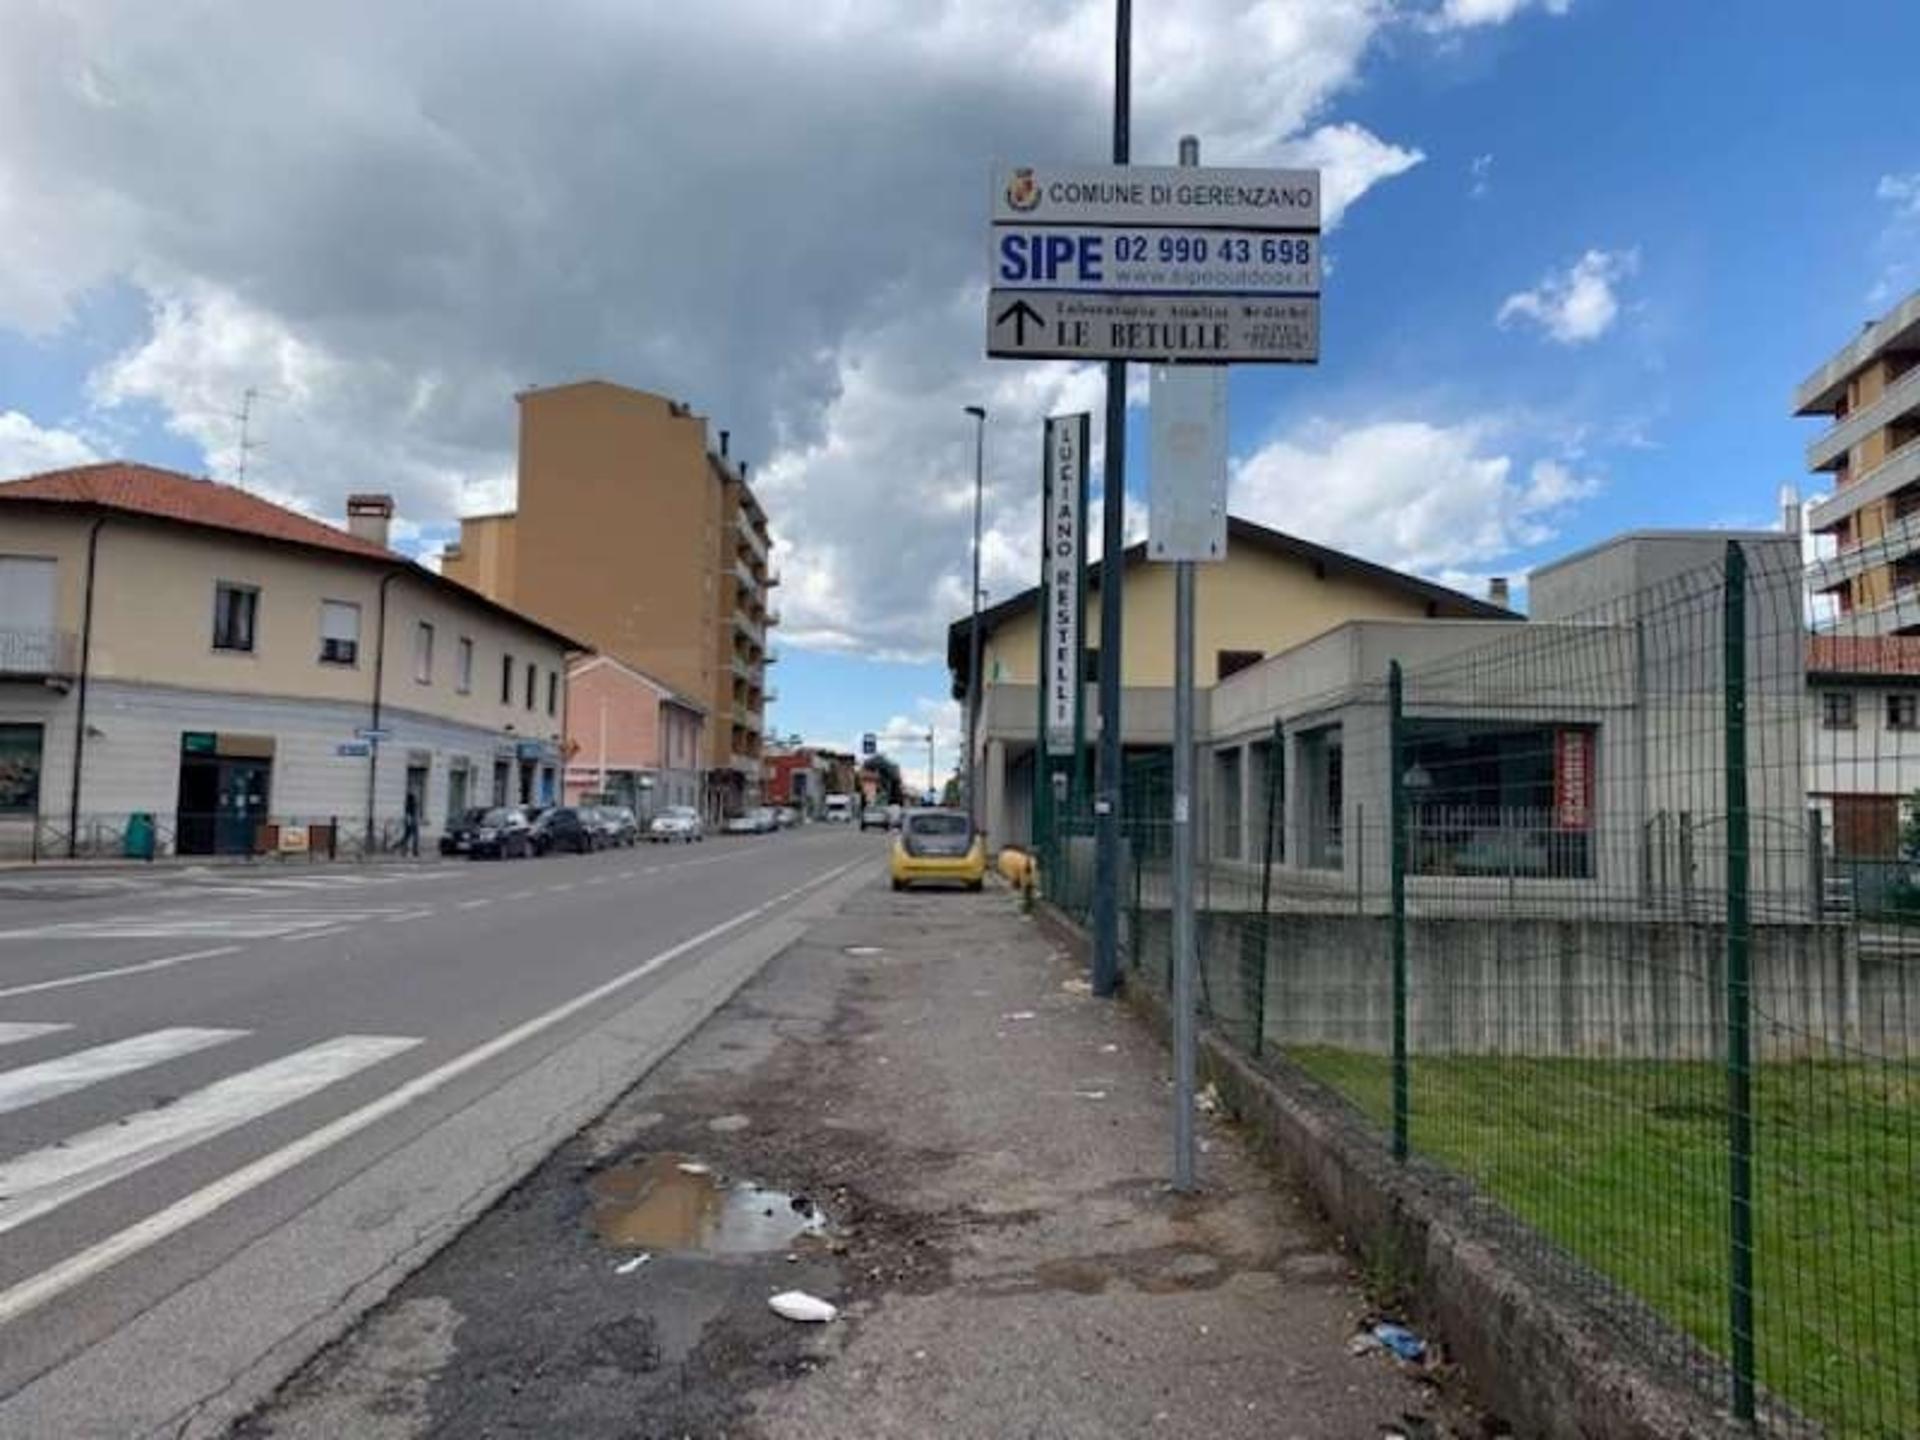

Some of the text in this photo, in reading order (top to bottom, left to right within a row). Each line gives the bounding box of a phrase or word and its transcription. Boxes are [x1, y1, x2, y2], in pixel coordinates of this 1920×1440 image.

[1049, 183, 1313, 208] COMUNE DI GERENZANO
[1001, 234, 1310, 282] SIPE 02 990 43 698
[1057, 320, 1090, 347] LE
[1111, 322, 1230, 350] BETULLE
[1056, 428, 1072, 557] LUCIANO
[1055, 570, 1072, 722] RESTELLI
